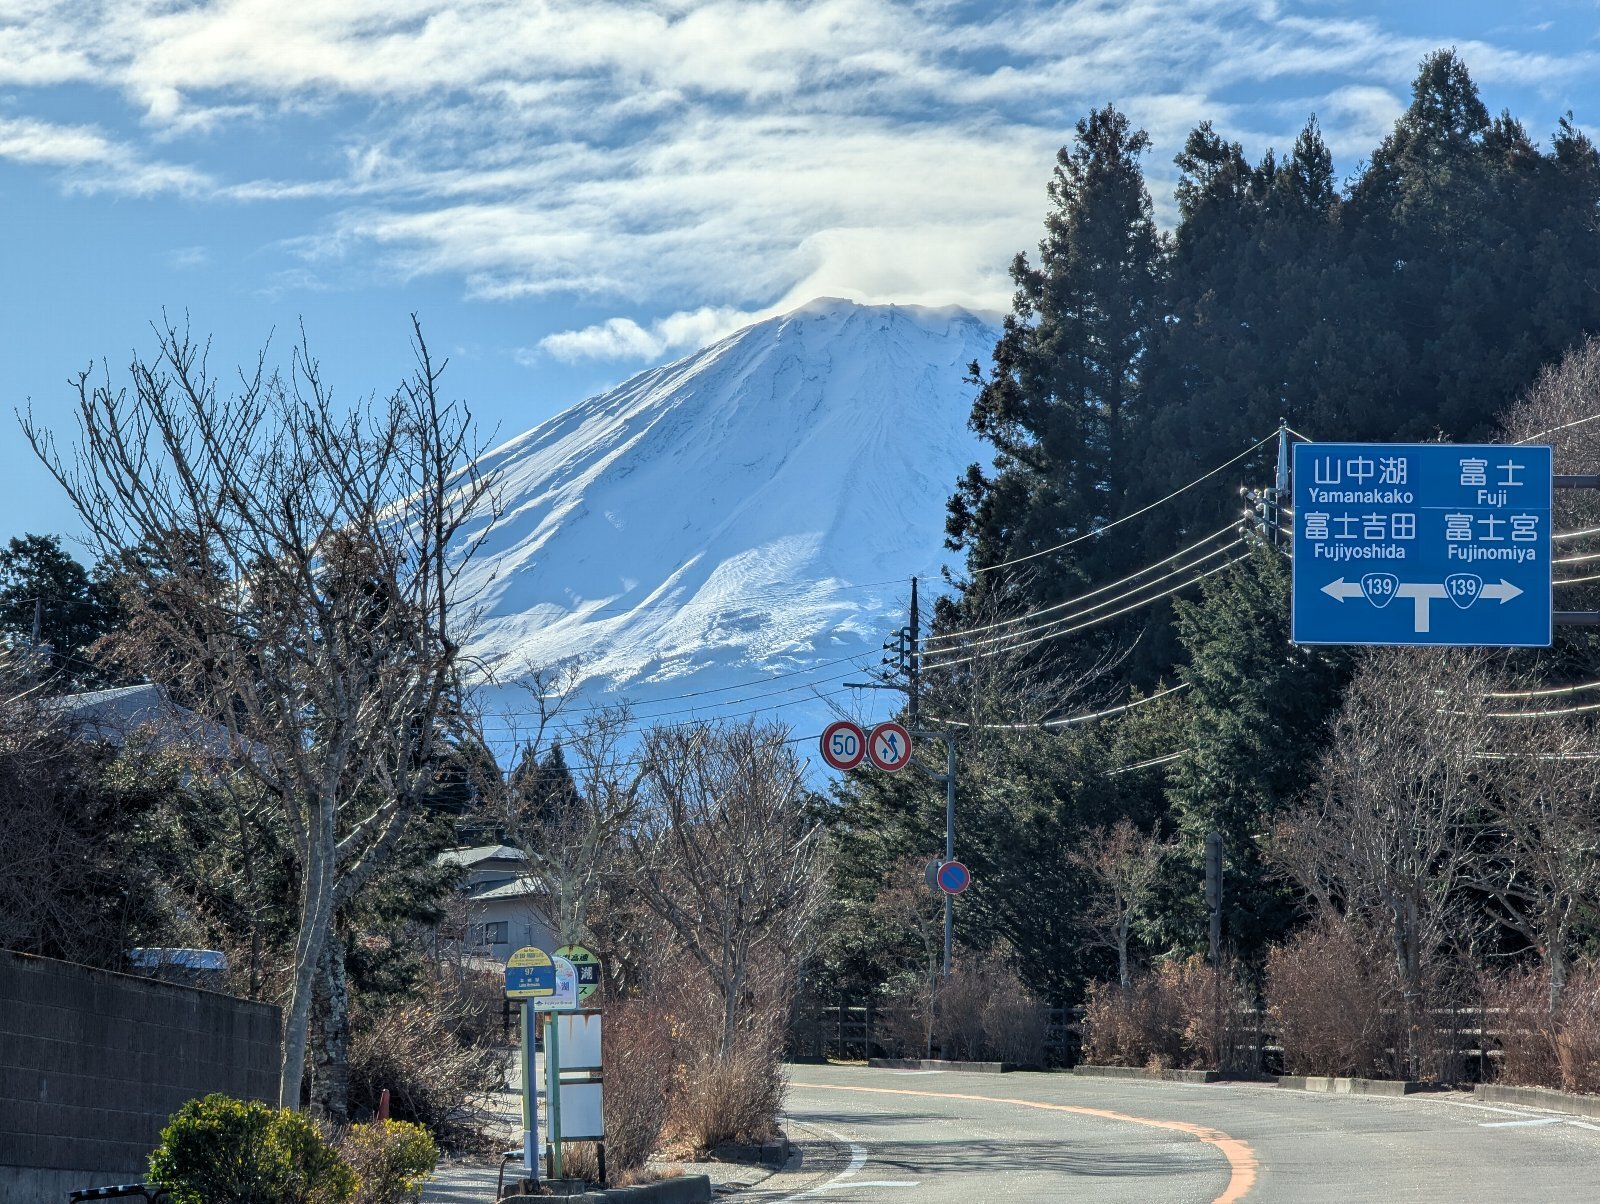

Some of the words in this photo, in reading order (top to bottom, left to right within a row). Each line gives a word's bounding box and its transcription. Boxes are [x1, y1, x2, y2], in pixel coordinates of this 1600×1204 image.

[1314, 456, 1408, 486] 山中湖
[1459, 457, 1526, 487] 富士
[1308, 488, 1414, 504] Yamanakako
[1477, 490, 1507, 508] Fuji
[1304, 511, 1416, 540] 富士吉田
[1444, 513, 1540, 542] 富士宮
[1314, 543, 1406, 562] Fujiyoshida
[1447, 544, 1536, 563] Fujinomiya
[1366, 578, 1393, 595] 139
[1449, 579, 1476, 596] 139
[832, 734, 856, 756] 50
[524, 968, 534, 976] 97
